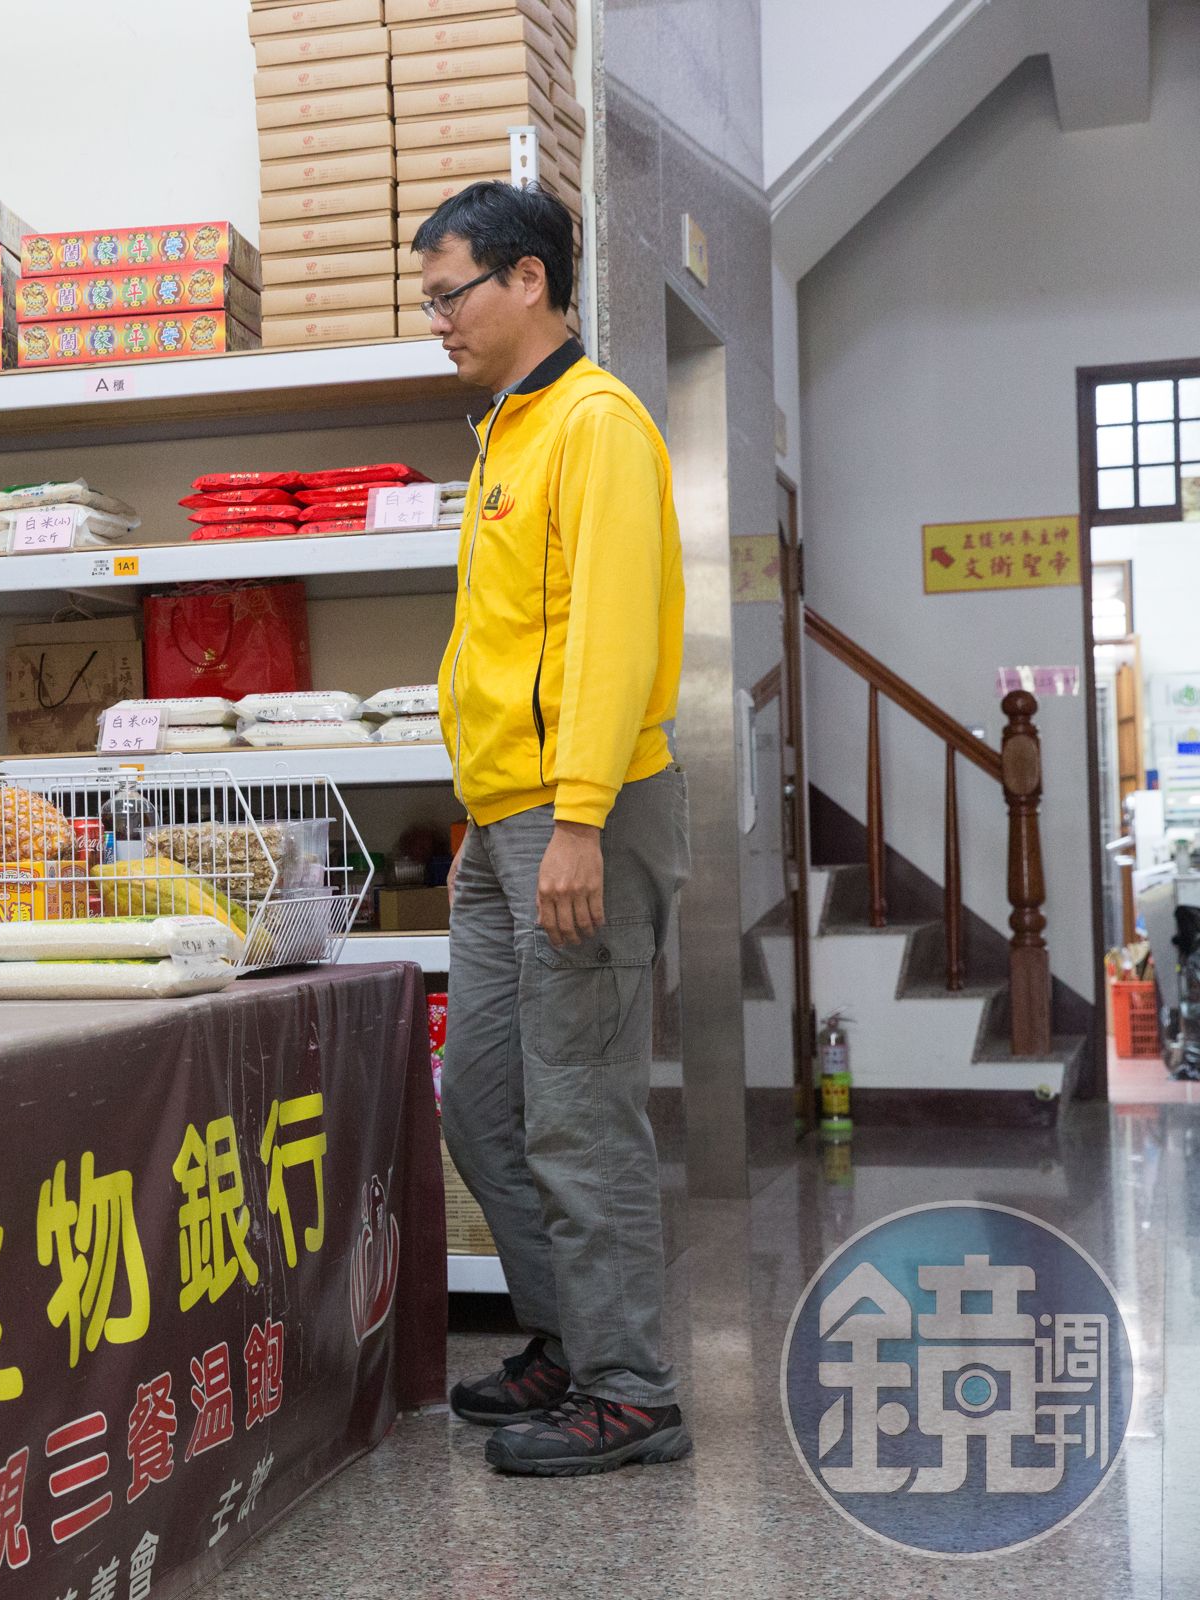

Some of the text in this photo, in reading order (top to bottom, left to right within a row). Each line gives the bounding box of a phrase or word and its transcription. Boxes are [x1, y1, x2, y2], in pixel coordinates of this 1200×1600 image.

[64, 237, 183, 261] 闔家平安
[59, 282, 178, 306] 闔家平安
[60, 327, 180, 352] 闔家平安
[386, 489, 425, 506] 白米
[24, 533, 58, 545] 2公斤
[117, 561, 135, 571] 1A1
[108, 738, 144, 749] 3公斤
